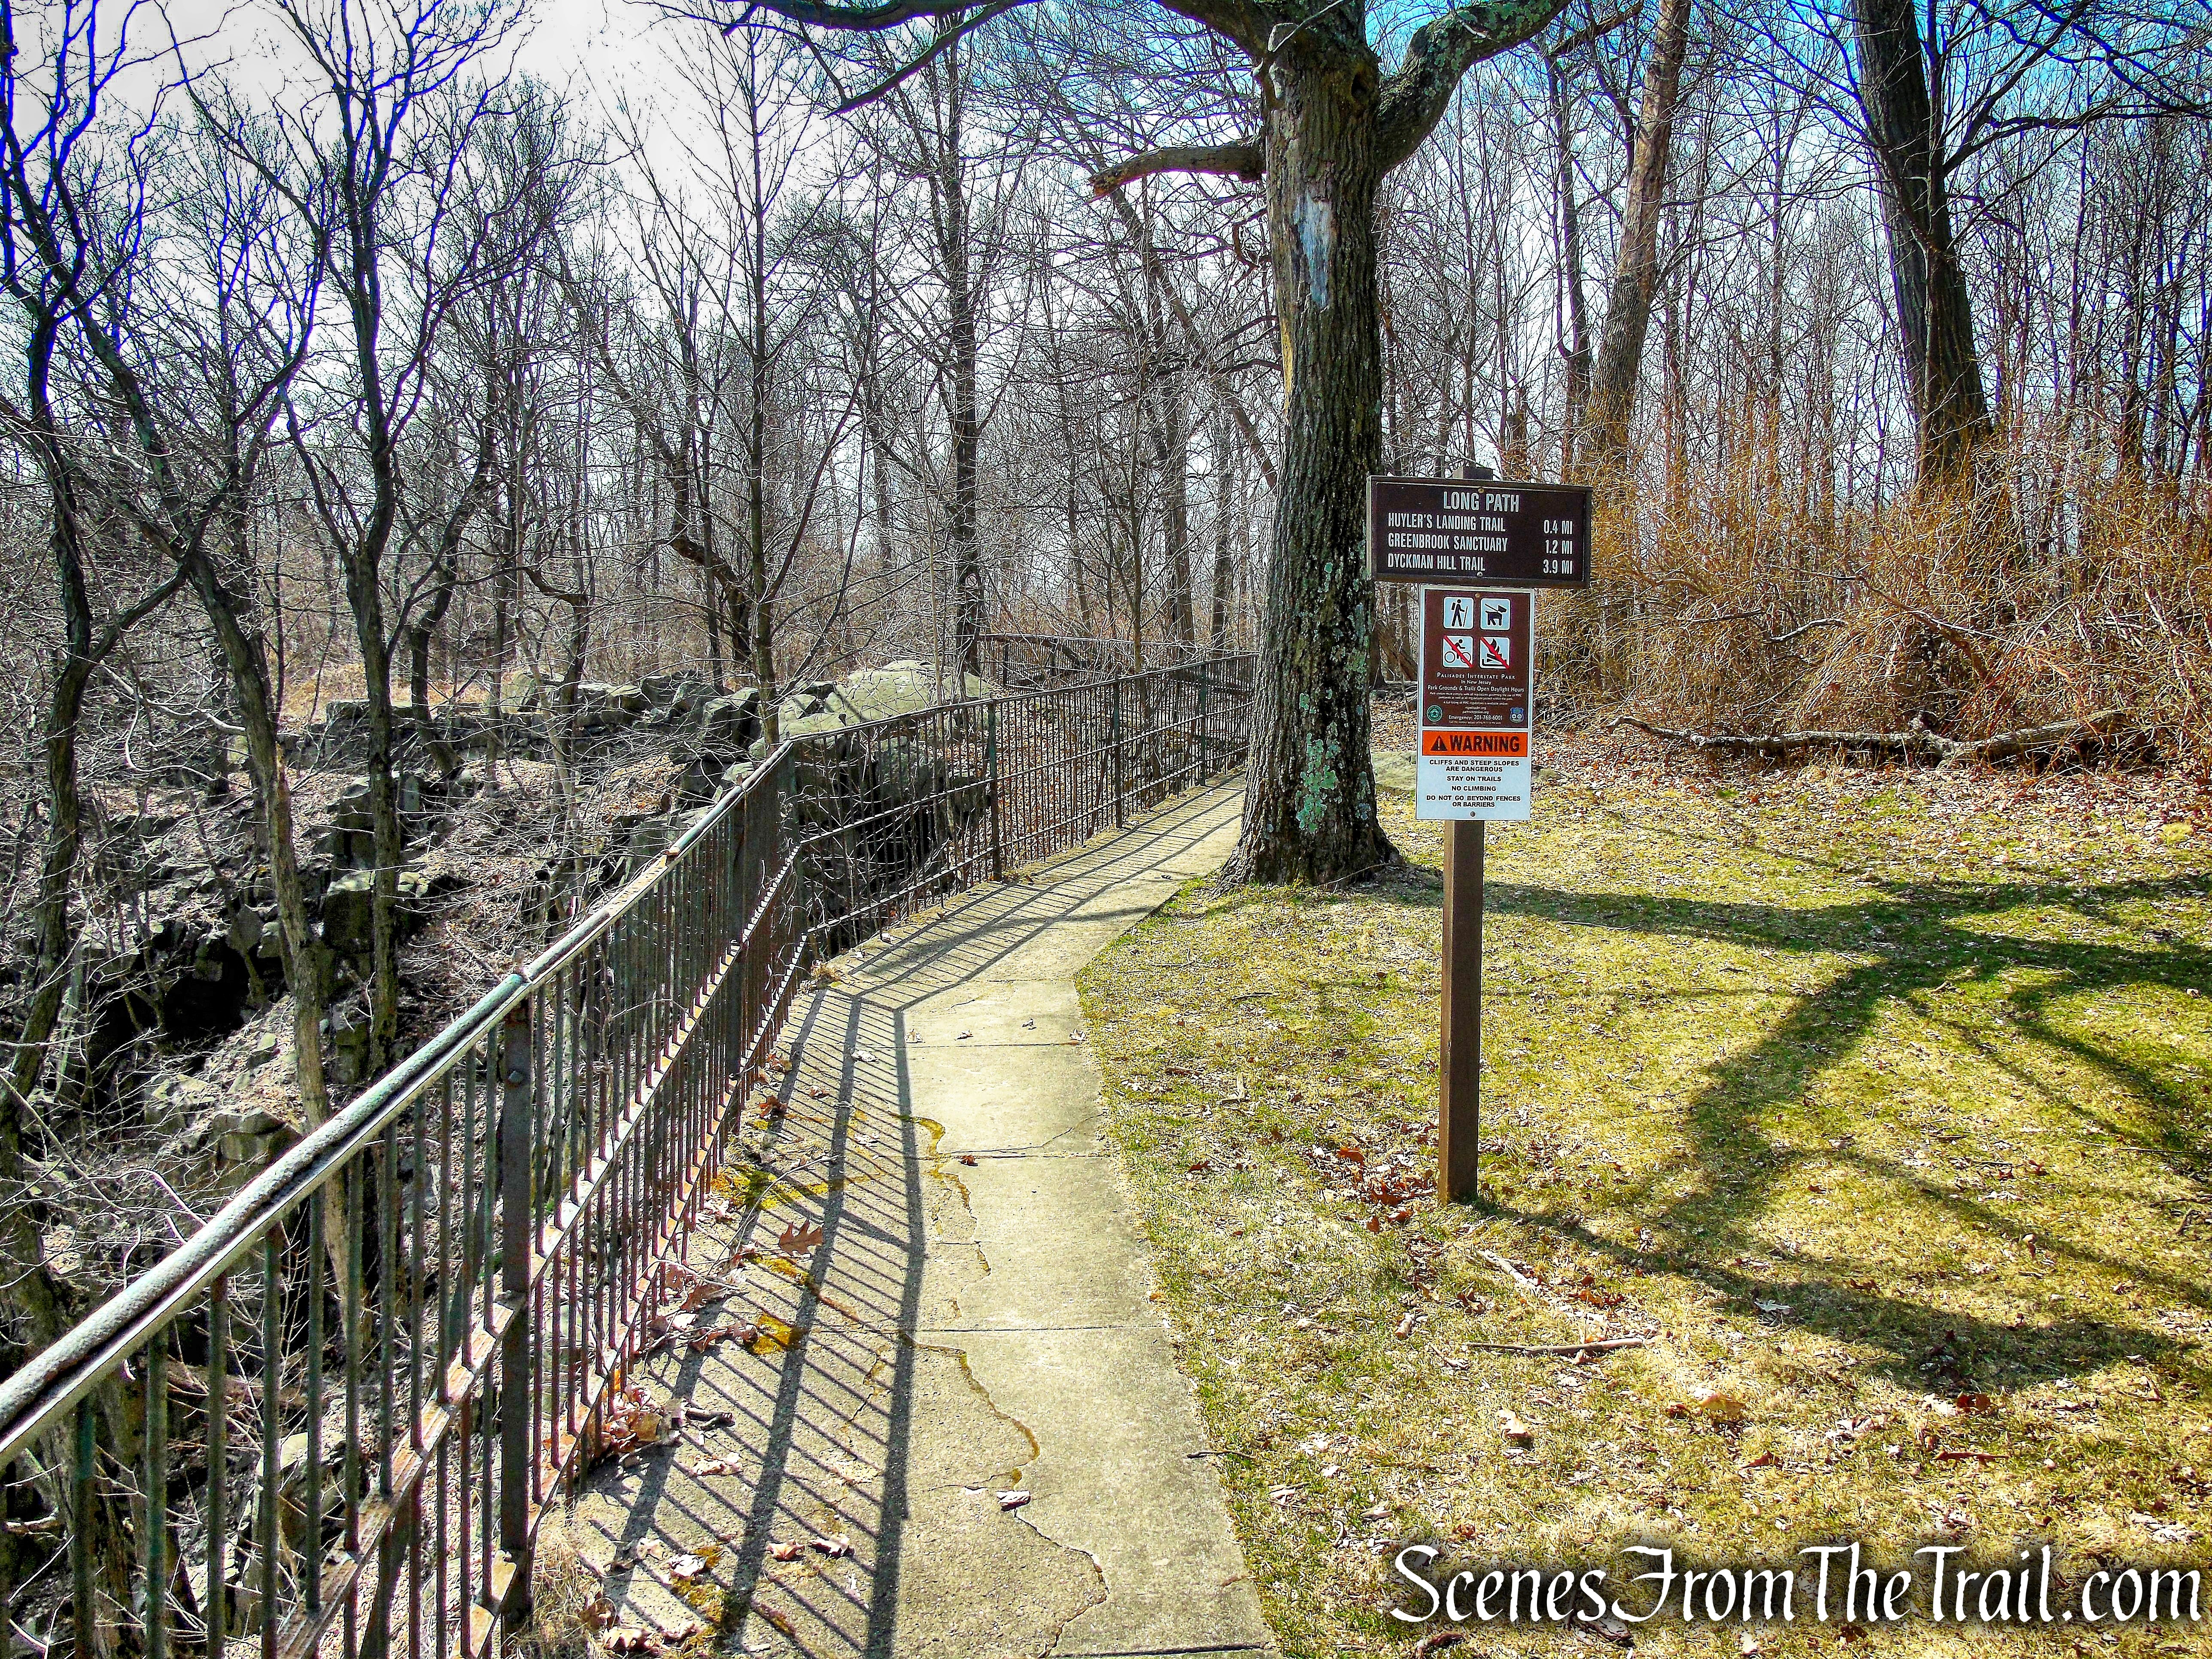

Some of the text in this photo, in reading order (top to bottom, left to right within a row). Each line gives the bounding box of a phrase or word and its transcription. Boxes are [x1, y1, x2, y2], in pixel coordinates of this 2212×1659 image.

[1443, 491, 1519, 512] LONG PATH
[1388, 512, 1506, 532] HUYLER'S LANDING TRAIL
[1544, 520, 1573, 535] 0.4 MI
[1388, 532, 1508, 552] GREENBROOK SANCTUARY
[1546, 539, 1573, 554] 1.2 MI
[1388, 553, 1486, 571] DYCKMAN HILL TRAIL
[1543, 559, 1573, 574] 3.9 MI
[1449, 735, 1520, 752] WARNING
